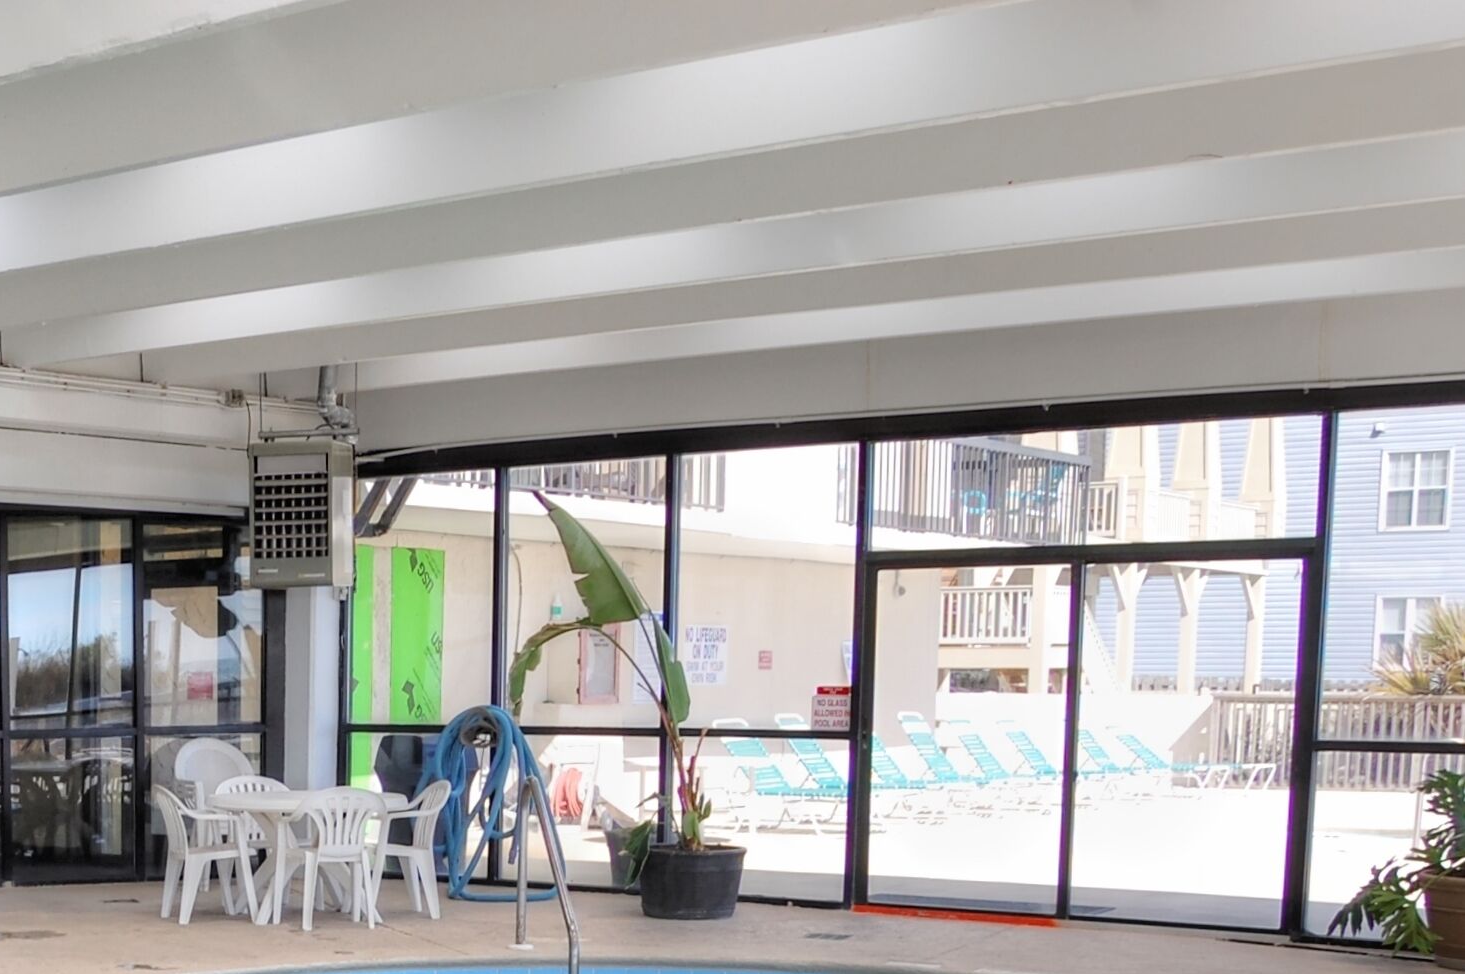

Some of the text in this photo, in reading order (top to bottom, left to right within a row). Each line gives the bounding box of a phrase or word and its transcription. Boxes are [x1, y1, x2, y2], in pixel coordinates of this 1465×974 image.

[417, 562, 435, 594] USG
[685, 627, 726, 643] NO LIFEGUARD
[693, 644, 718, 659] ON DUTY
[817, 699, 848, 707] NO GLASS
[814, 710, 843, 718] ALLOWED
